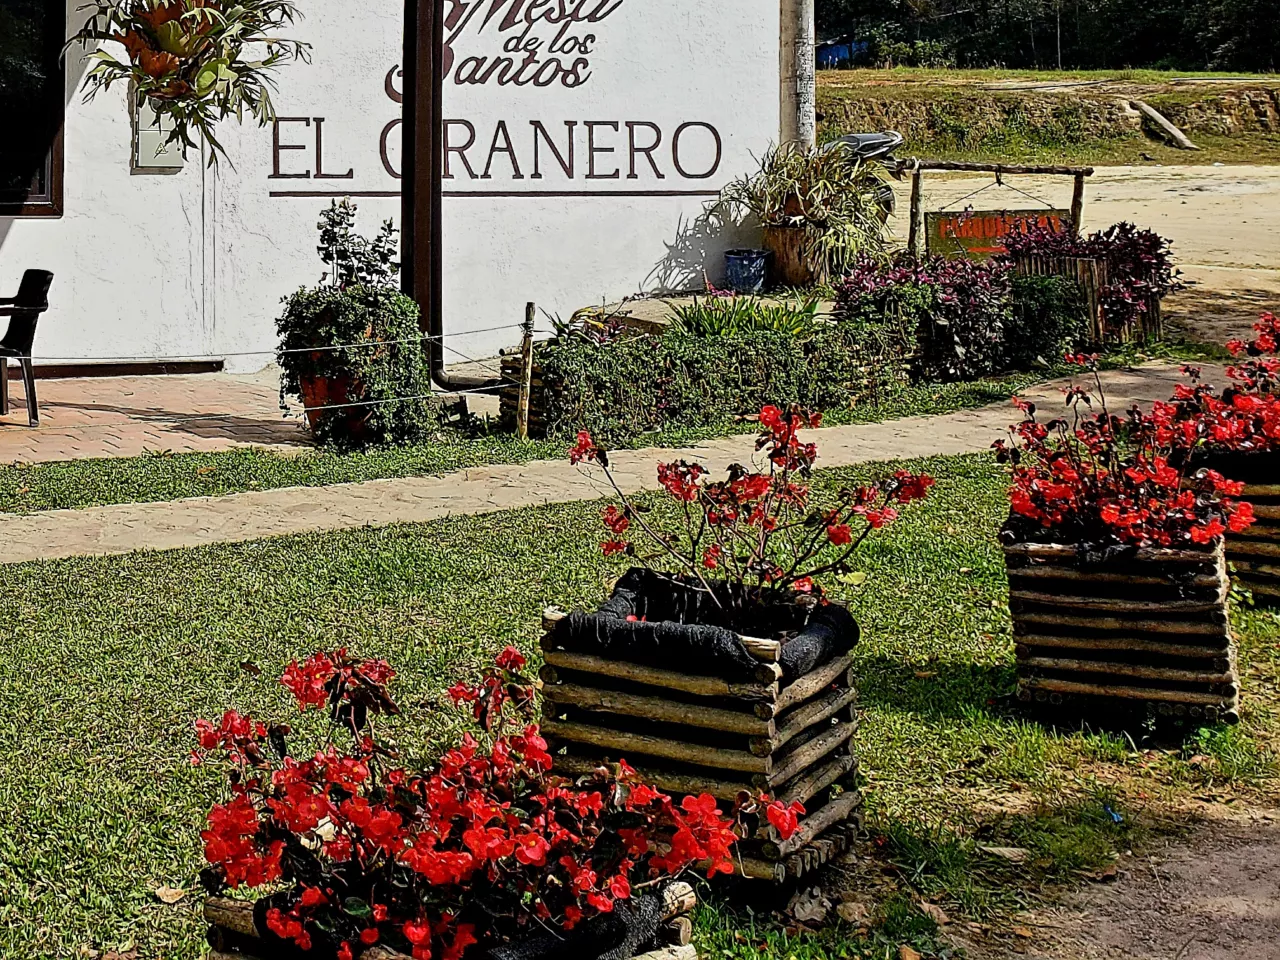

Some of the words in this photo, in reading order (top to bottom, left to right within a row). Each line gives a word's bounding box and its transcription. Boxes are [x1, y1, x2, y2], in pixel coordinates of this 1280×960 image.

[503, 23, 544, 53] de
[548, 19, 596, 54] los
[267, 117, 354, 180] EL
